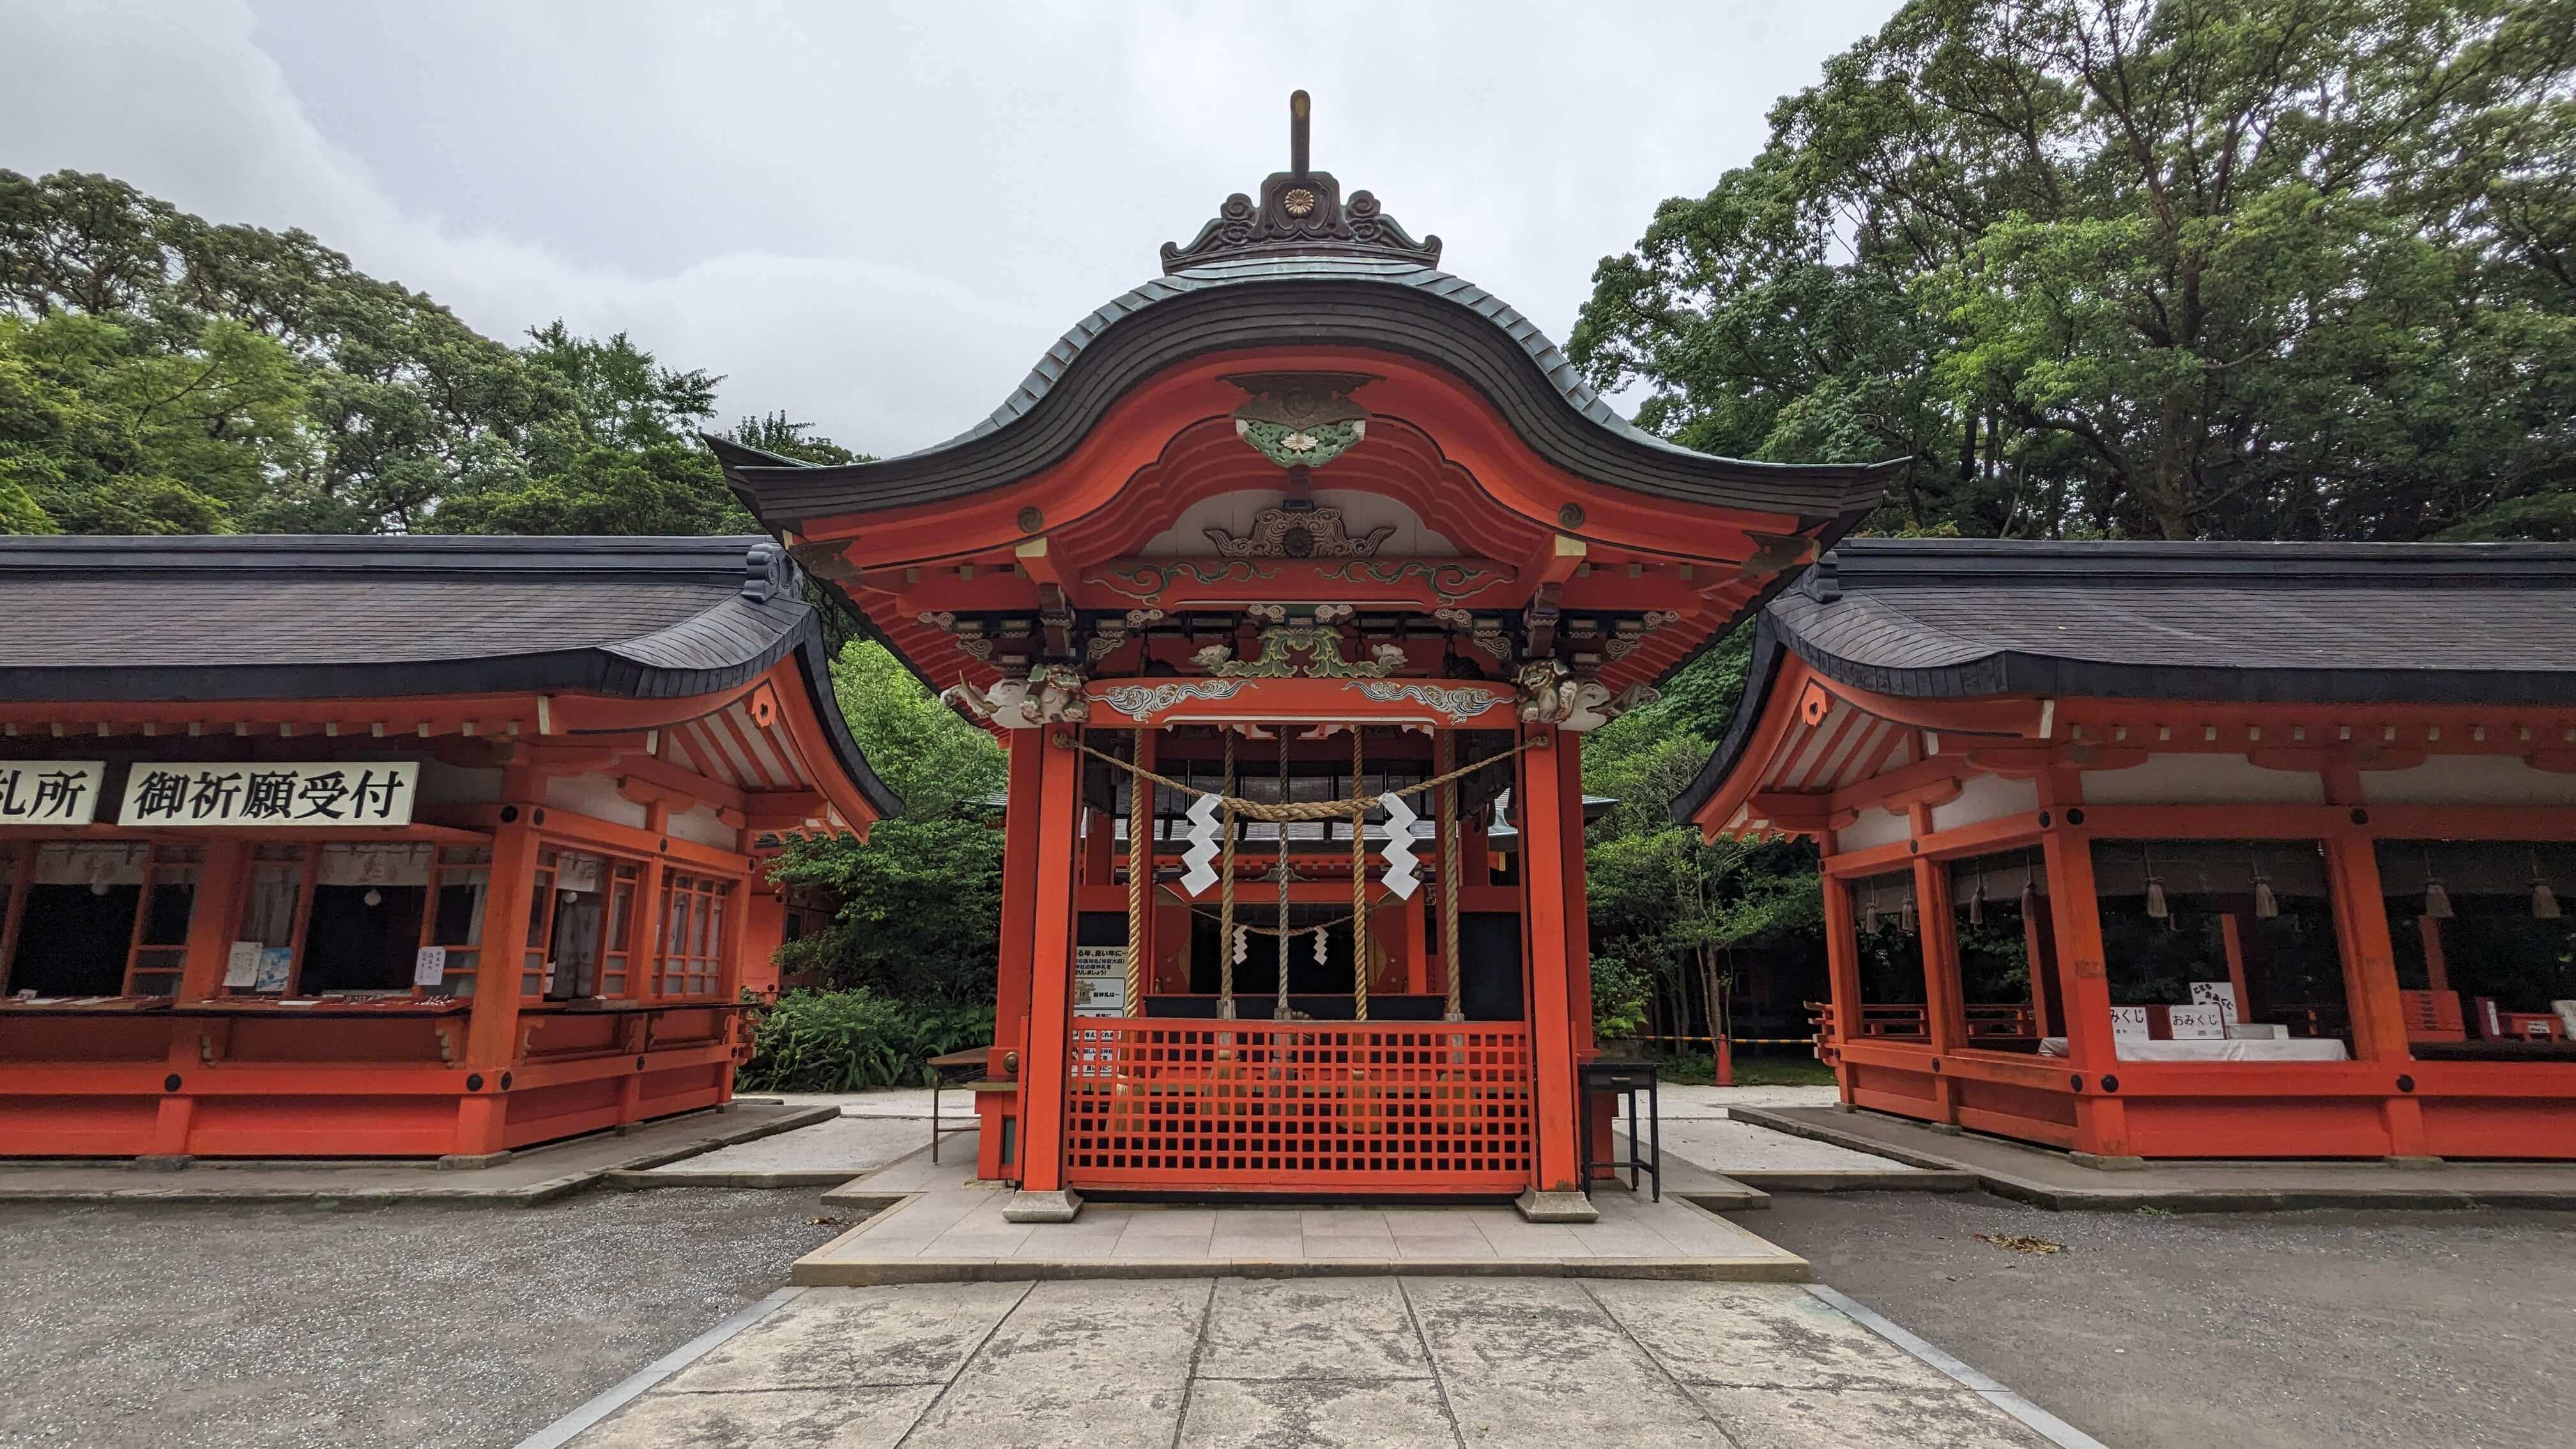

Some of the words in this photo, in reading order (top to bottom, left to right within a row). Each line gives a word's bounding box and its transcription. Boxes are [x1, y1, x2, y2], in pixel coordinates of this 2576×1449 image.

[133, 769, 404, 820] 御祈願受付
[2173, 1014, 2218, 1026] おみくじ
